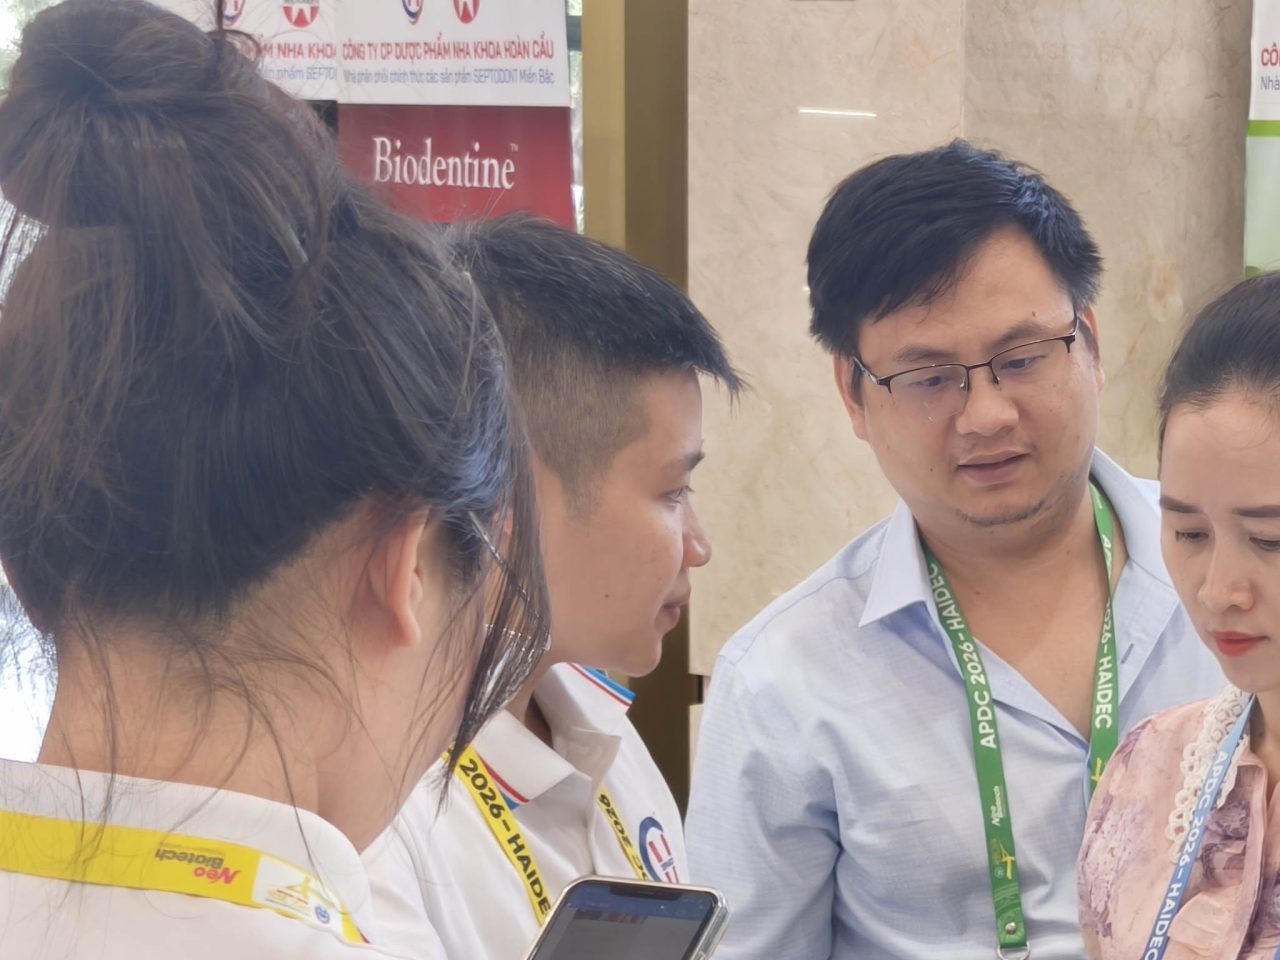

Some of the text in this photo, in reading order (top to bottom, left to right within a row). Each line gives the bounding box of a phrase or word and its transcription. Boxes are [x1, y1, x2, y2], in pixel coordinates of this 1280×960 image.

[343, 37, 365, 60] CÔNG
[423, 31, 450, 60] PHẨM
[452, 41, 471, 60] NHA
[473, 40, 501, 60] KHOA
[503, 34, 530, 60] HOÀN
[532, 31, 554, 60] CẦU
[1260, 75, 1280, 91] Nhà
[373, 136, 515, 190] Biodentine
[928, 563, 997, 749] APDC 2026 HAIDEC
[1094, 655, 1113, 729] HAIDEC
[1198, 750, 1230, 810] APDC
[155, 848, 225, 871] Biotech
[459, 758, 552, 916] 2026 HAIDE
[1178, 814, 1205, 866] 2026
[193, 866, 242, 885] Neo
